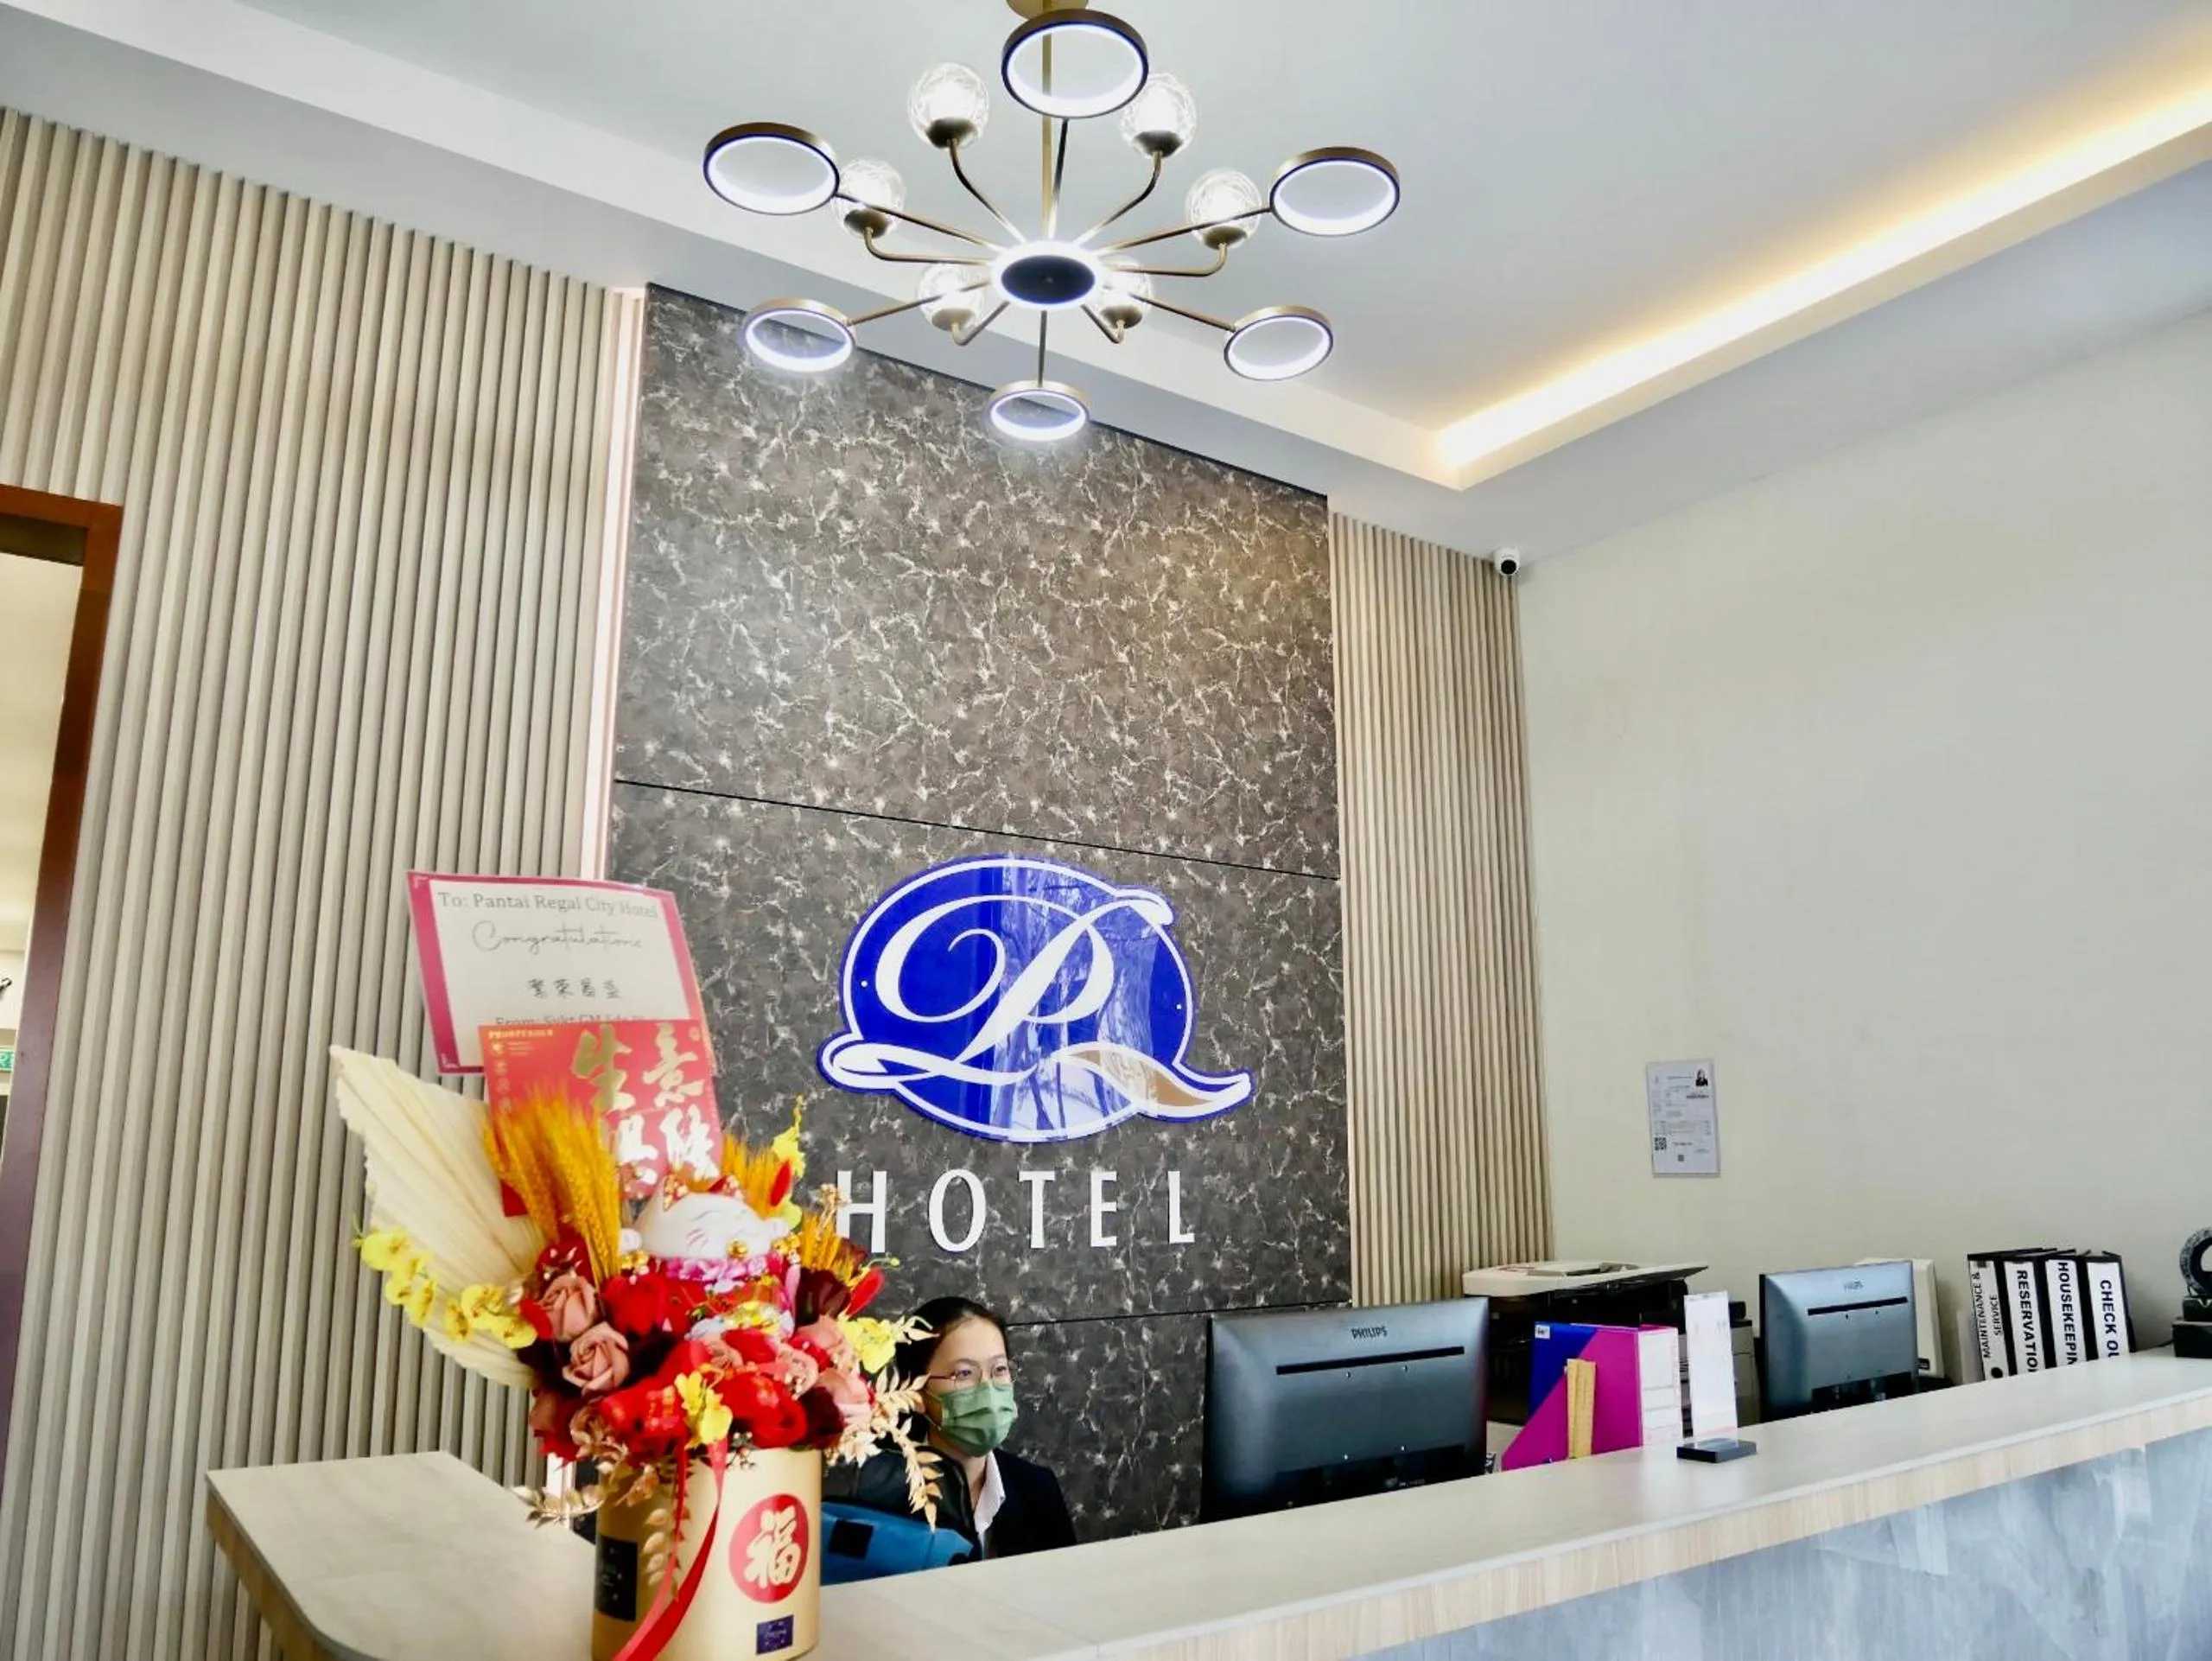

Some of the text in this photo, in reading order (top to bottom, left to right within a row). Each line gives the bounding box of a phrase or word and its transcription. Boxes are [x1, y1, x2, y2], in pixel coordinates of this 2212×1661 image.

[438, 891, 659, 920] To: Pantai Regal City Hotel
[472, 920, 643, 955] Congratulations
[569, 1022, 706, 1111] 生意
[836, 1168, 1196, 1253] HOTEL
[1351, 1326, 1388, 1340] PHILIPS
[1973, 1282, 1991, 1359] MAINTENANCE
[1989, 1294, 2003, 1336] SERVICE
[2100, 1279, 2117, 1334] CHECK
[743, 1505, 802, 1588] 福
